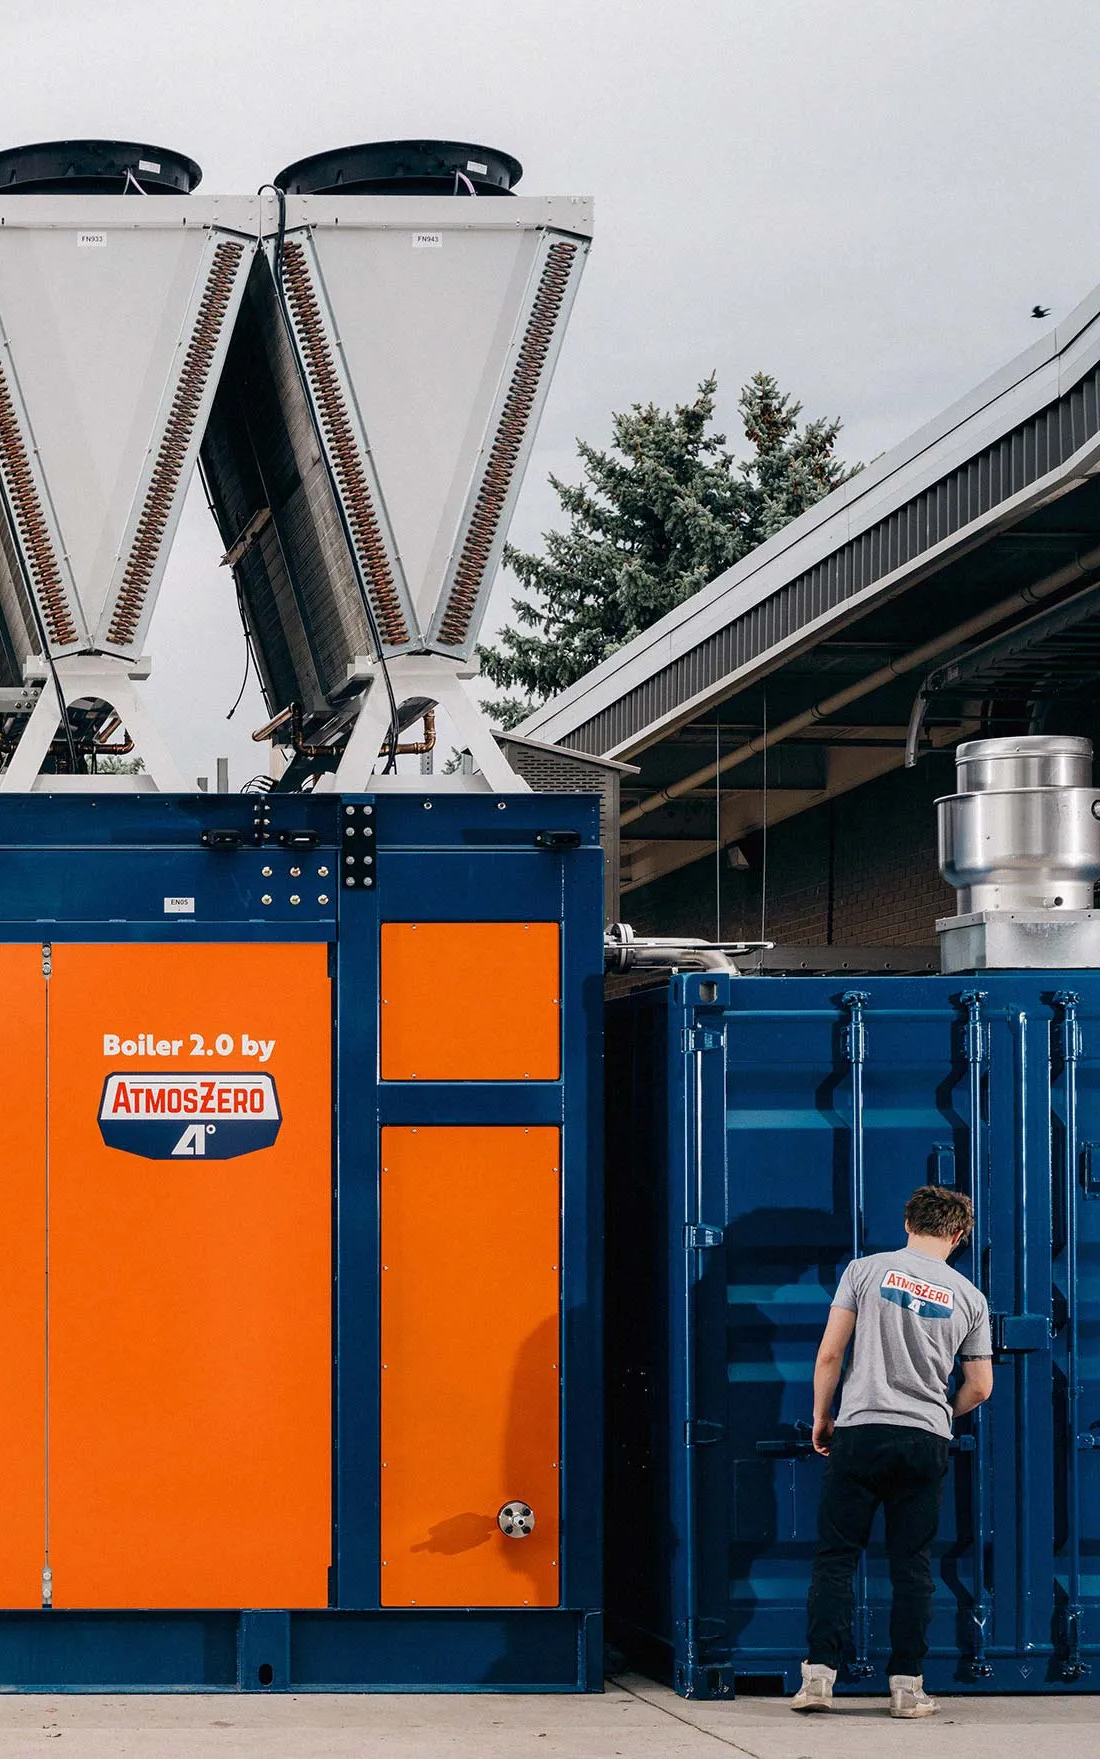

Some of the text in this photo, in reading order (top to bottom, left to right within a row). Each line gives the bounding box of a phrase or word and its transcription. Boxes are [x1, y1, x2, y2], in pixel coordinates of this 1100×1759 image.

[170, 898, 189, 906] EN05
[103, 1033, 276, 1062] Boiler 2.0 by
